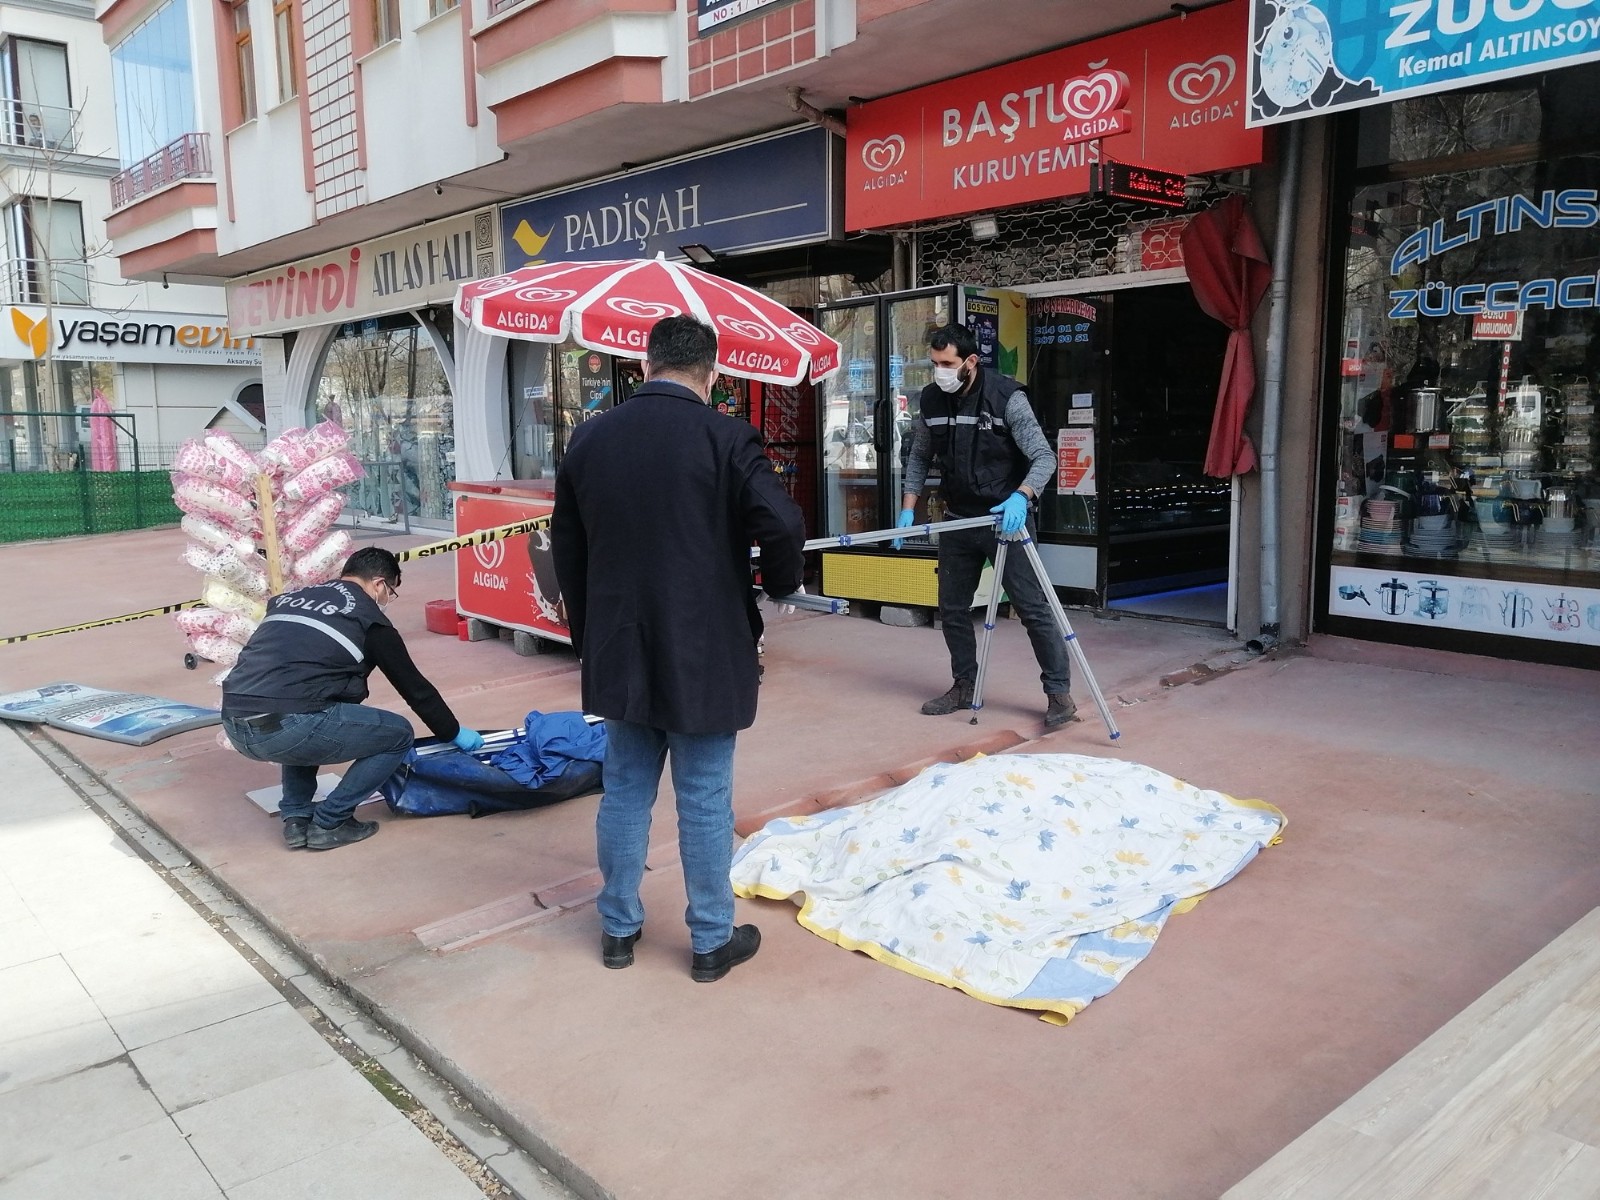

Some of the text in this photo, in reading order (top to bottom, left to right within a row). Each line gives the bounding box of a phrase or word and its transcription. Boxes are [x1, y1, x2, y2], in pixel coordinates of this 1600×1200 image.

[1398, 42, 1471, 78] Kemal
[563, 184, 701, 252] PADİŞAH
[1391, 189, 1600, 276] ALTINS
[372, 230, 474, 297] ATLAS HALI
[1388, 271, 1600, 319] ZÜCCAC
